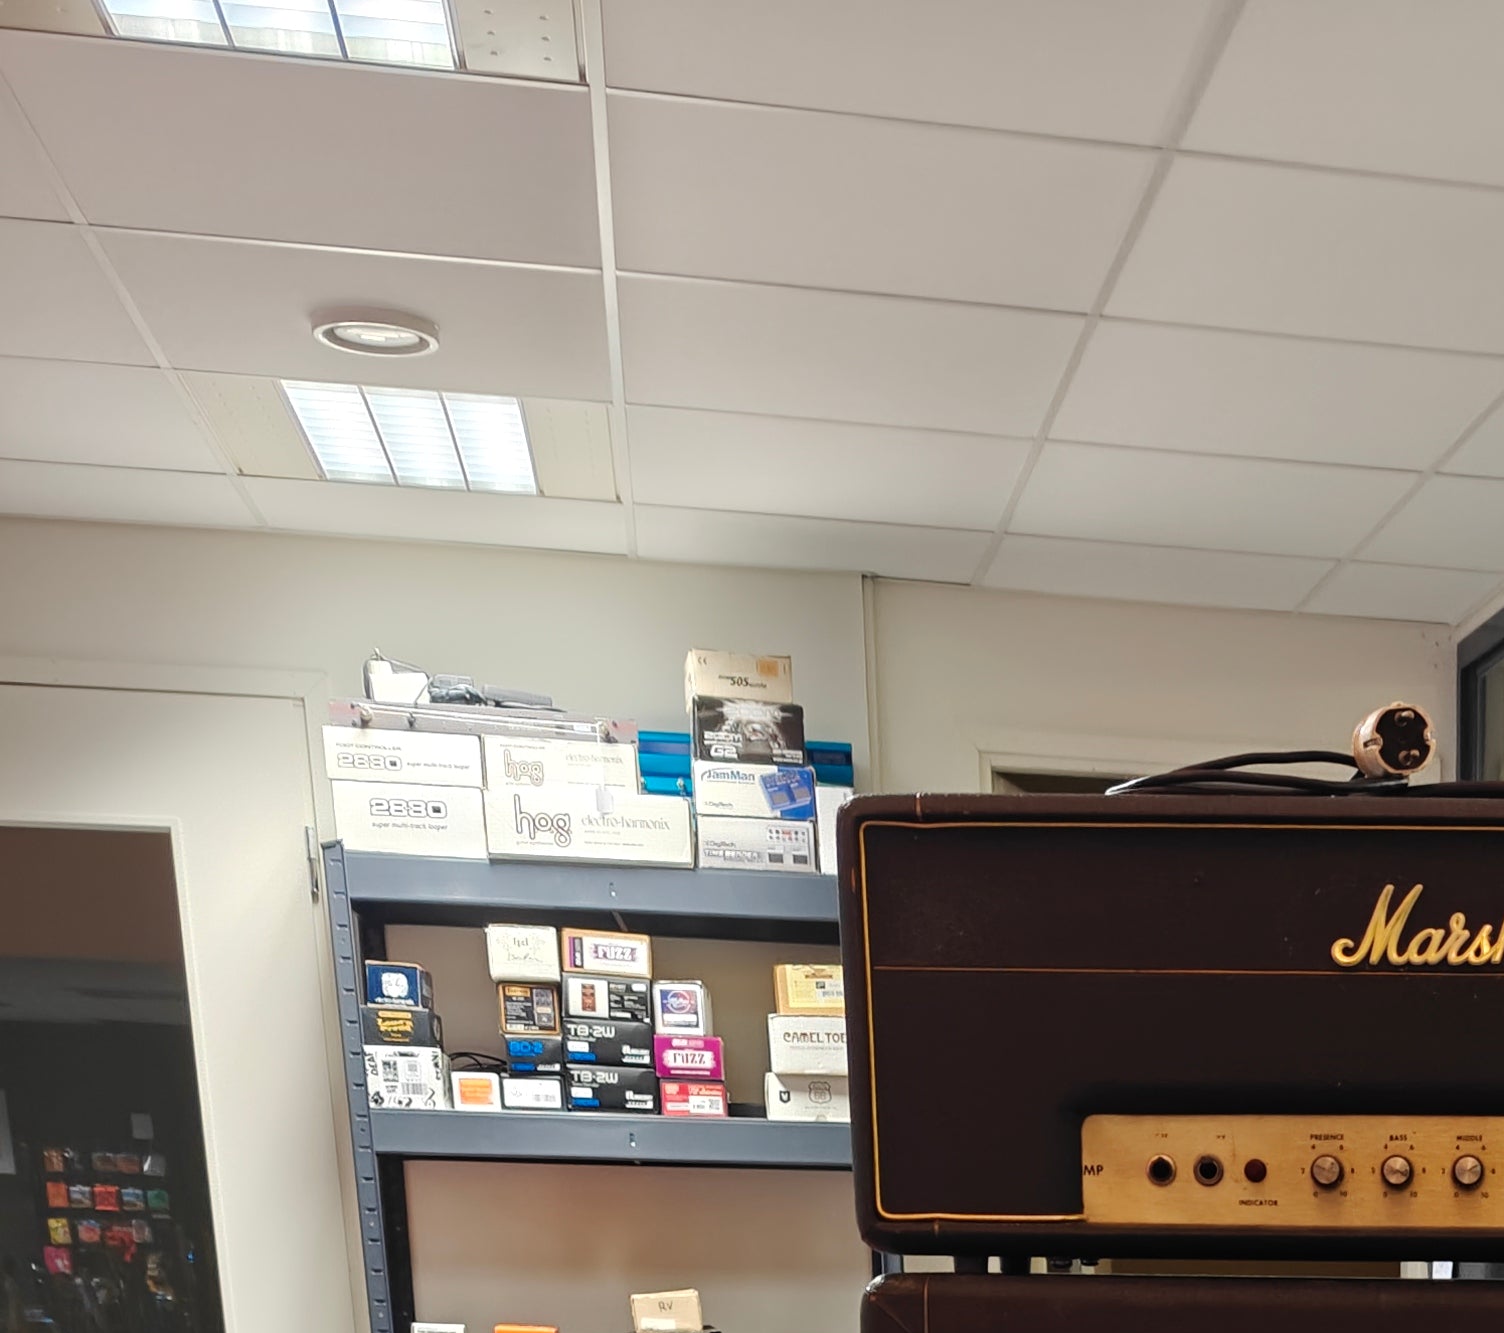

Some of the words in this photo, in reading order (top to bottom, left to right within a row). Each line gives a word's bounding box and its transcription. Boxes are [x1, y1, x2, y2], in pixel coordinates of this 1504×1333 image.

[337, 752, 402, 771] 2880
[504, 749, 544, 786] hog
[702, 769, 756, 782] JamMan
[369, 798, 447, 819] 2880
[514, 794, 571, 847] hog
[581, 814, 671, 831] electro-harmonix
[1310, 1133, 1344, 1141] PRESENCE
[1389, 1134, 1407, 1142] BASS
[1456, 1134, 1483, 1142] MIDDLE
[1083, 1165, 1104, 1175] MP
